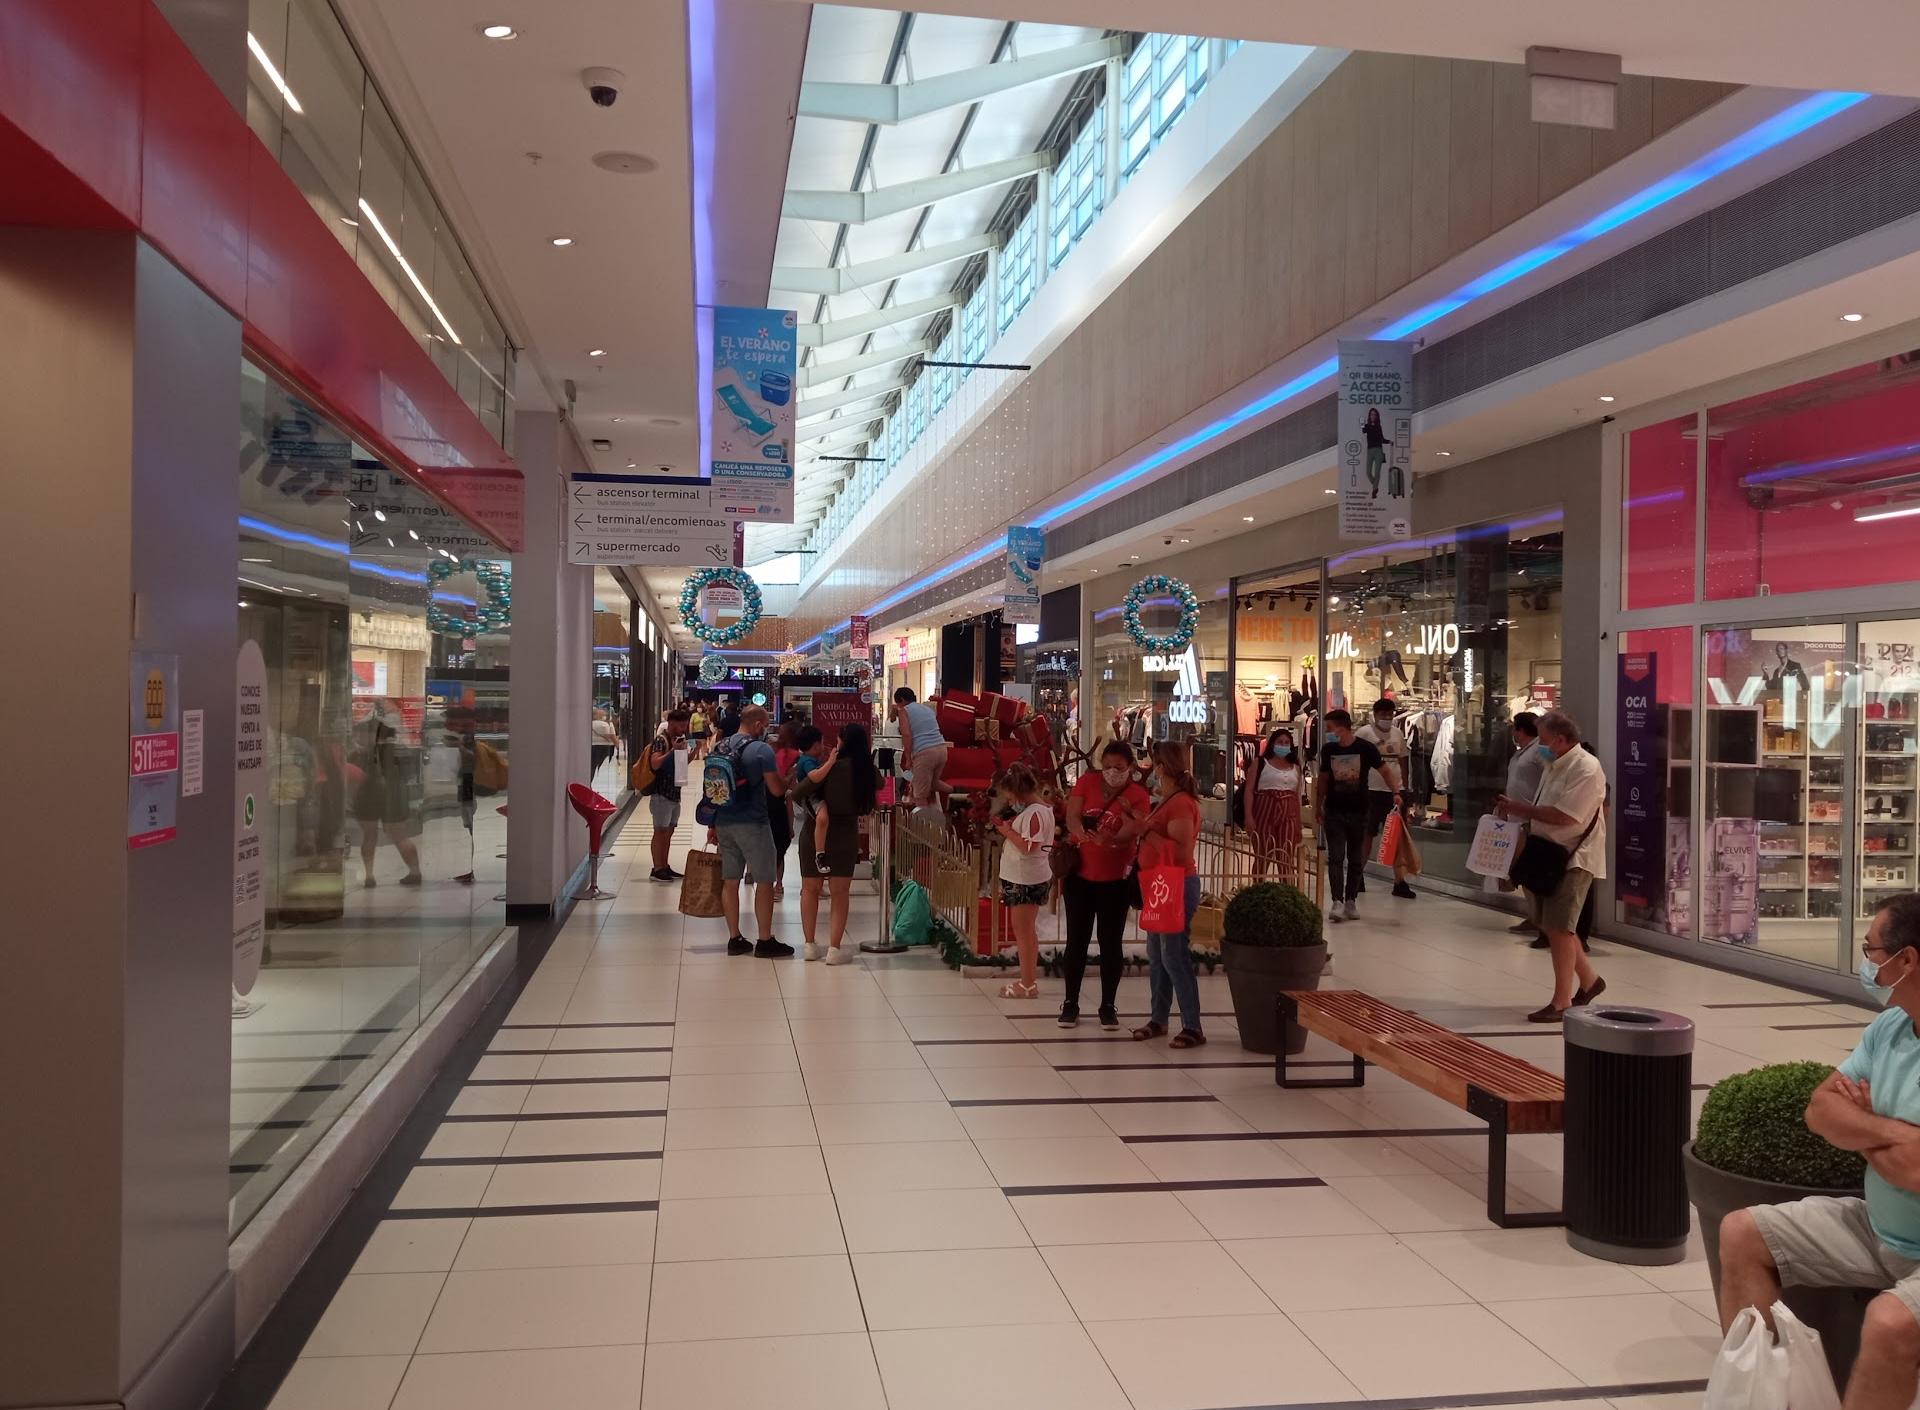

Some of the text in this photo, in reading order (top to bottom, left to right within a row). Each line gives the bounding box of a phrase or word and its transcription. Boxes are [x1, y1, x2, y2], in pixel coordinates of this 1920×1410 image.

[721, 336, 791, 352] EL VERANO
[727, 347, 786, 364] te espera
[1349, 372, 1361, 380] QR
[1363, 372, 1373, 380] EN
[1350, 381, 1401, 393] ACCESO
[1349, 394, 1402, 405] SEGURO
[597, 488, 700, 501] ascensor terminal
[596, 542, 681, 553] supermercado
[743, 668, 765, 677] LIFE
[1625, 696, 1648, 708] OCA
[240, 703, 261, 716] NUESTRA
[1168, 694, 1208, 724] adidas
[240, 721, 261, 734] VENTA A
[255, 739, 263, 751] DE
[133, 739, 152, 772] 511
